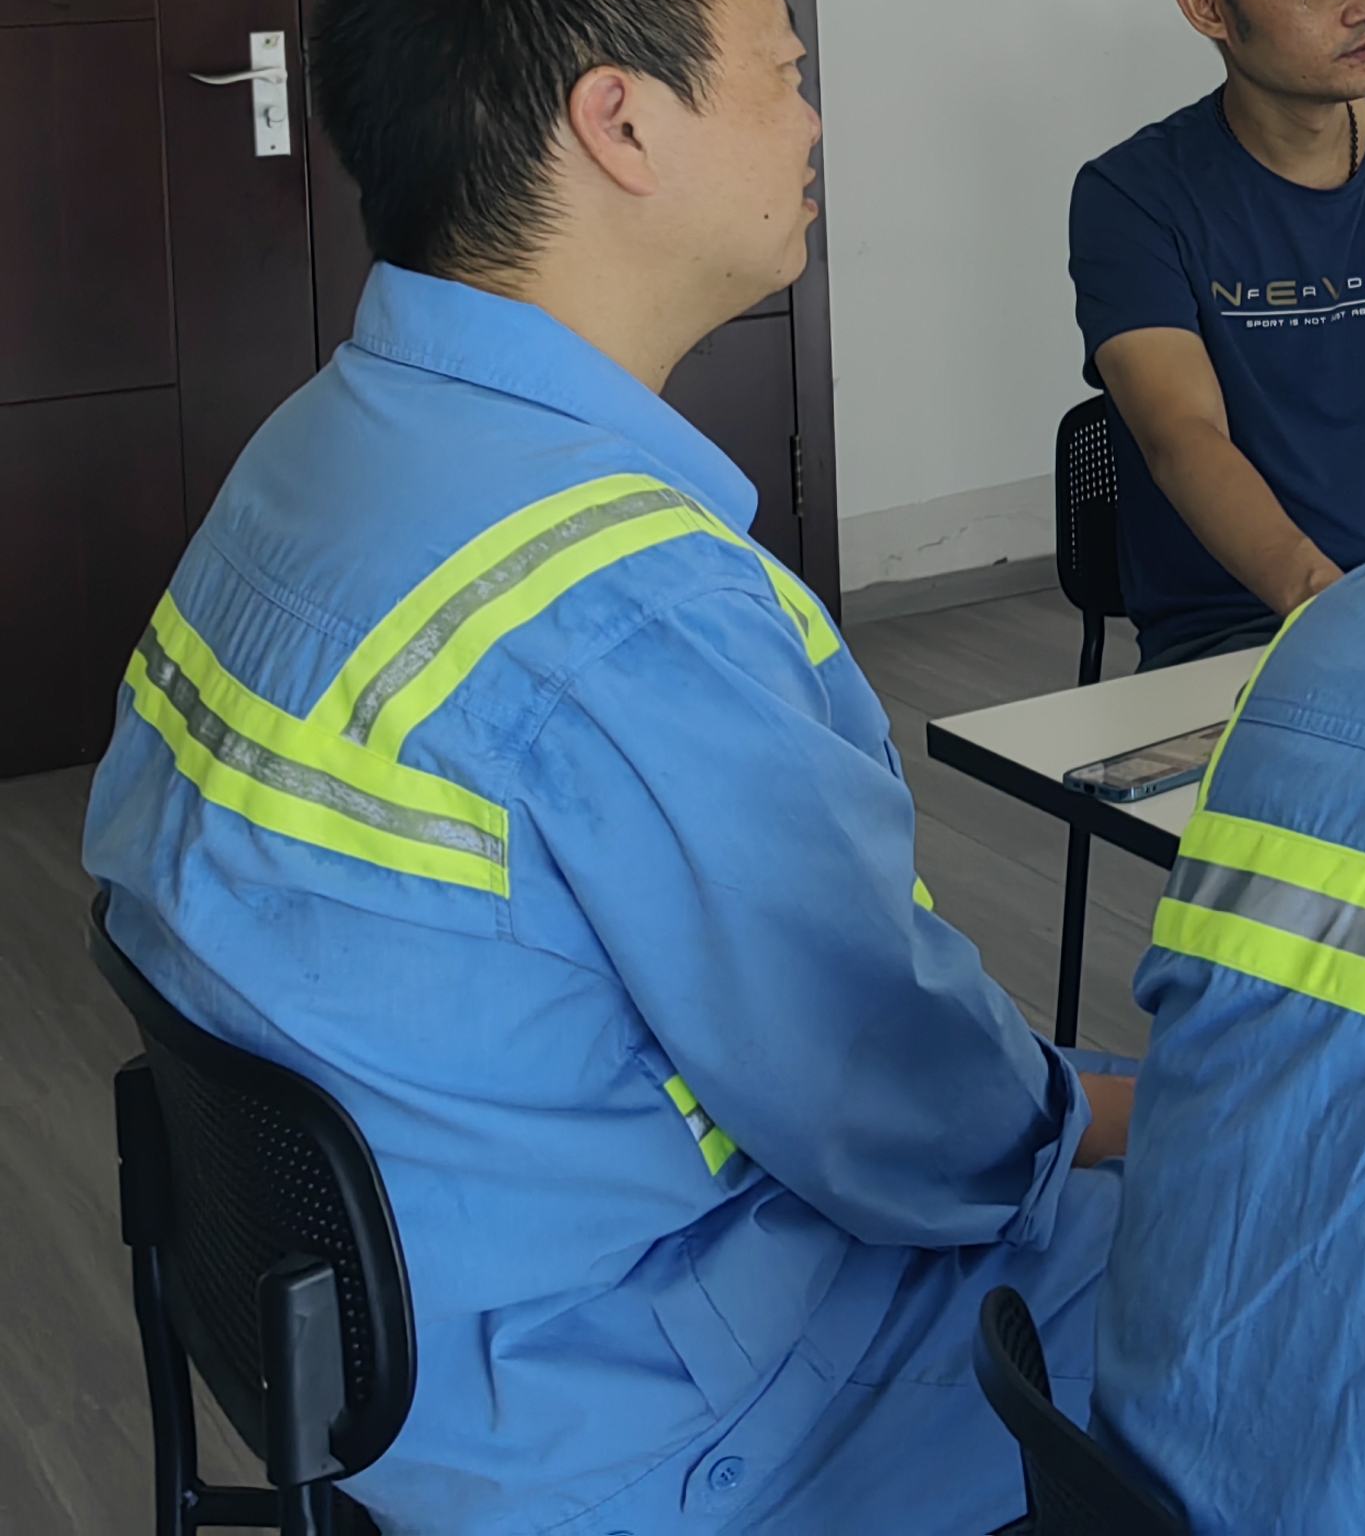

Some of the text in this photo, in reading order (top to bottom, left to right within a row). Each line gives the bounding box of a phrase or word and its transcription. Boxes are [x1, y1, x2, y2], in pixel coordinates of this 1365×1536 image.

[1246, 319, 1284, 328] SPORT
[1290, 318, 1299, 326] IS
[1304, 316, 1326, 325] NOT
